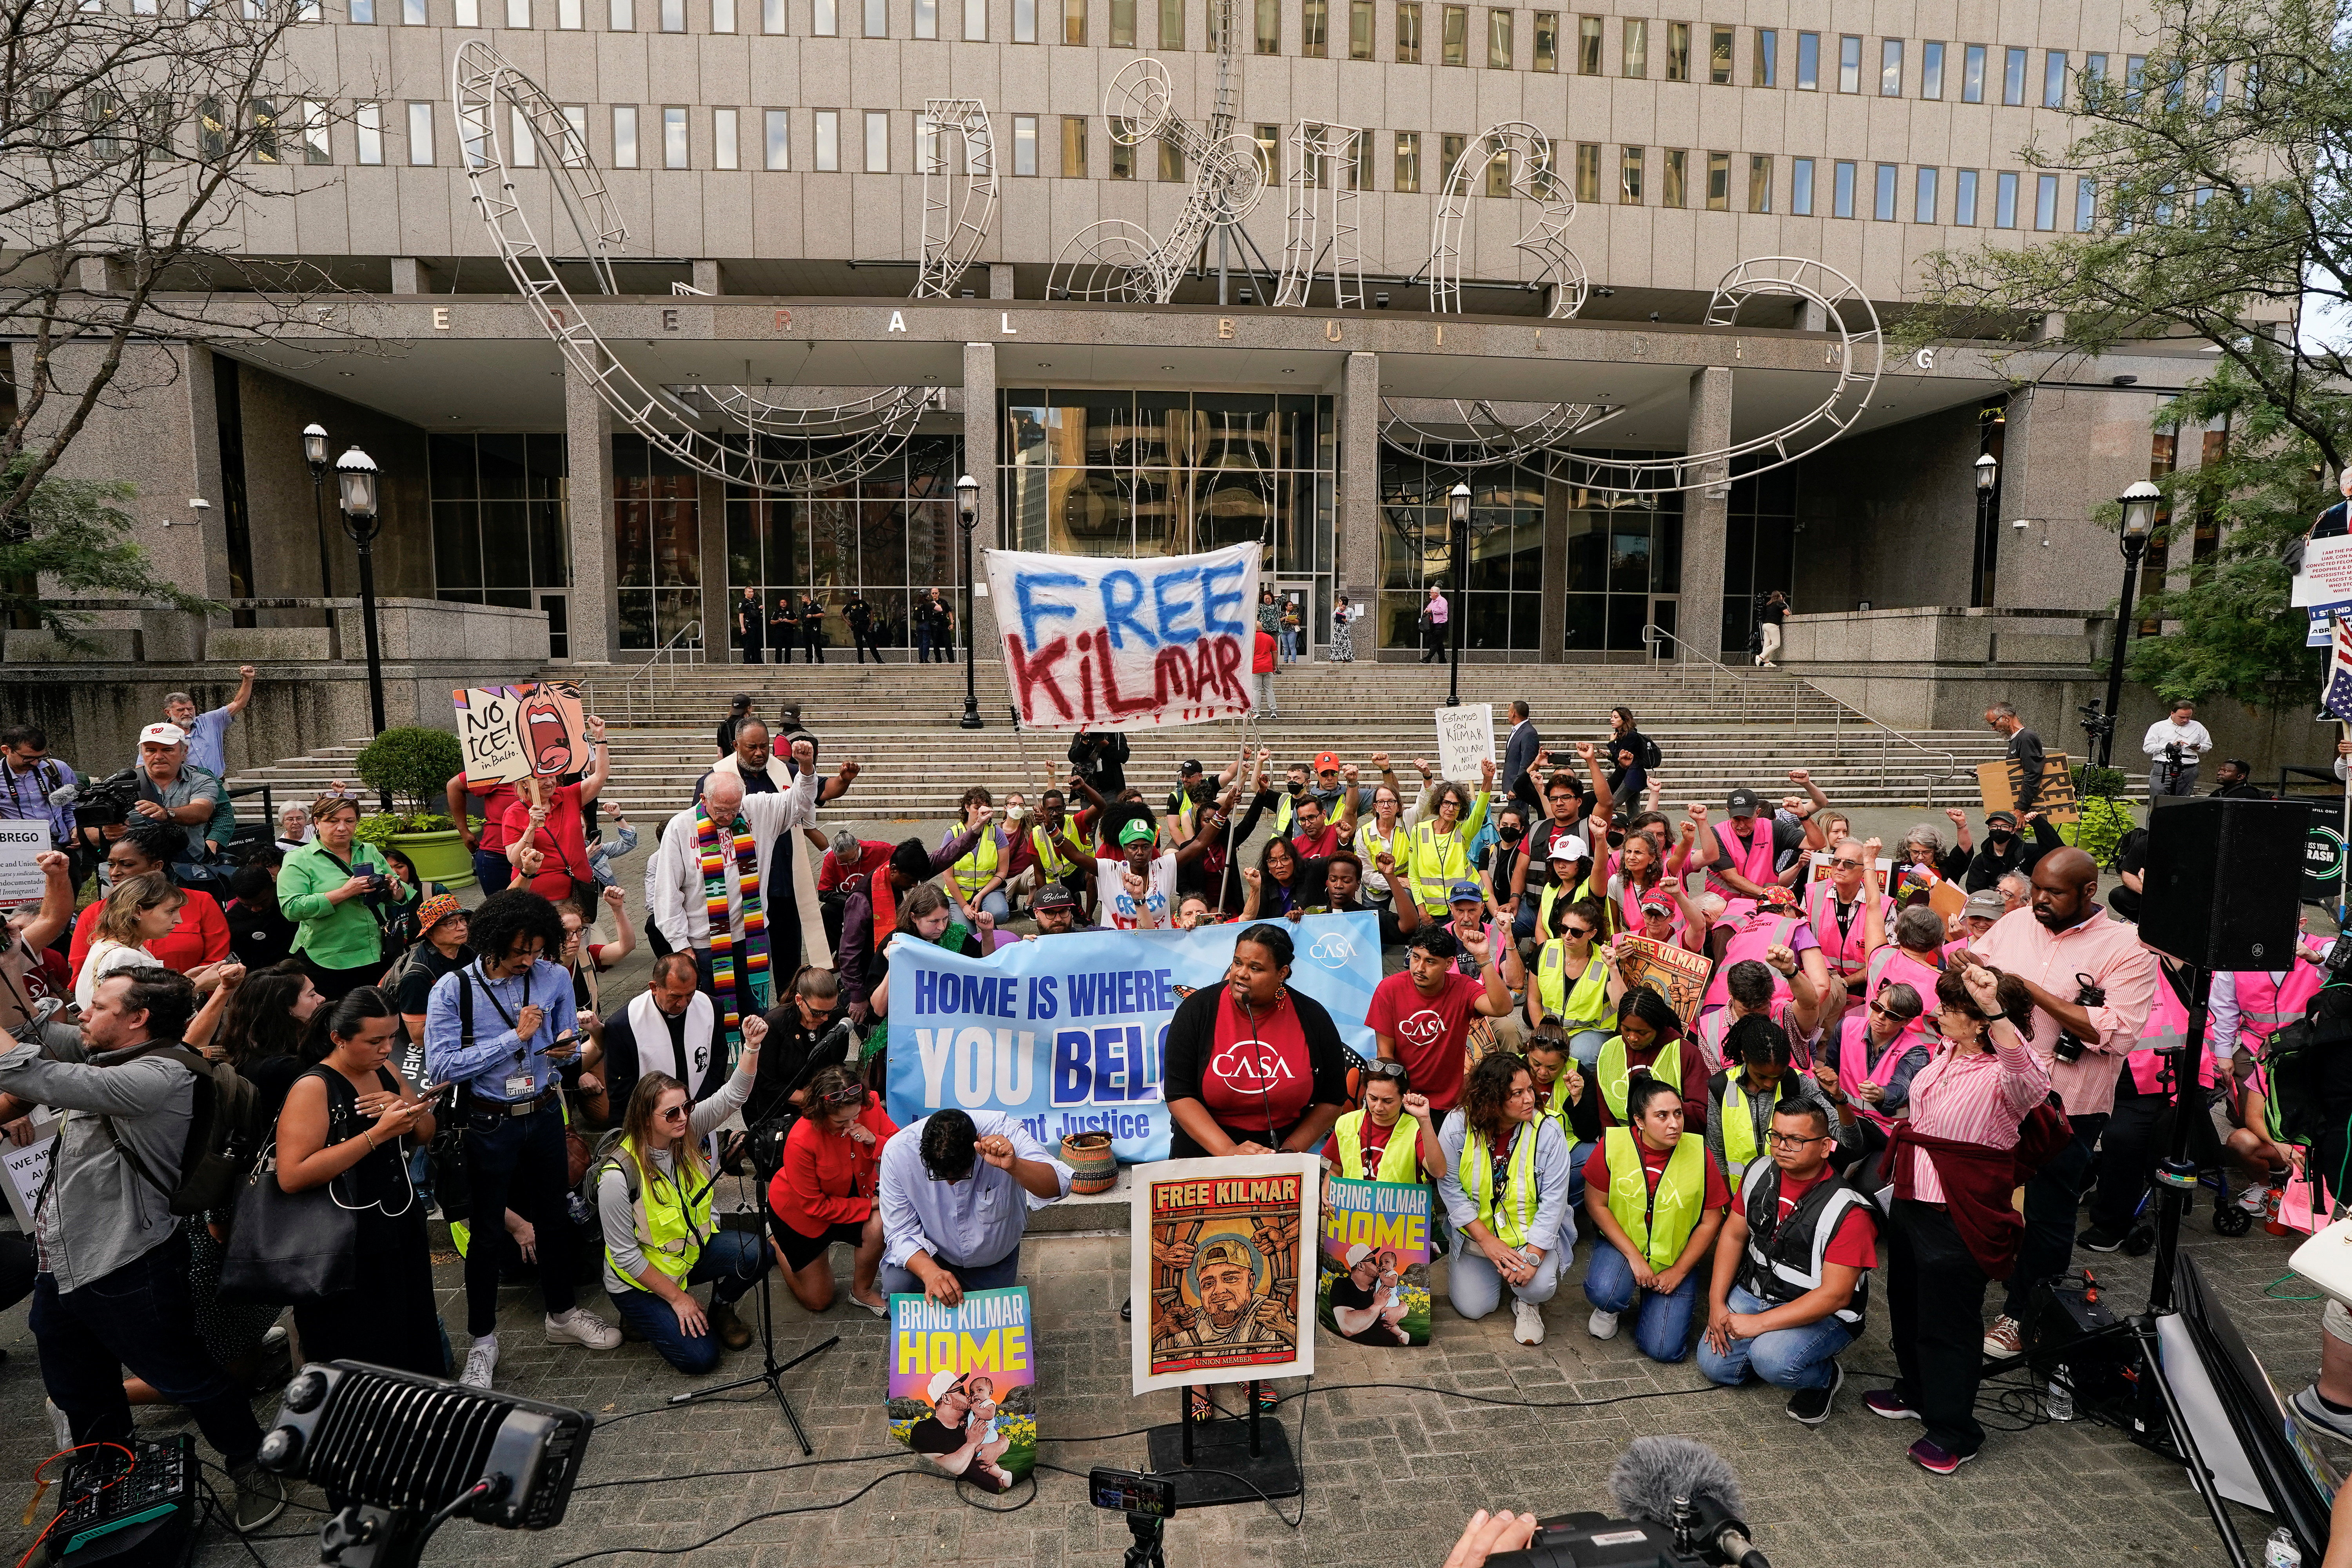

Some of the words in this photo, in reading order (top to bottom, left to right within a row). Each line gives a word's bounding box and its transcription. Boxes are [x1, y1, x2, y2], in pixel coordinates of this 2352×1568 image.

[317, 307, 1018, 334] FEDERAL
[1218, 318, 1934, 369] BUILDING
[1015, 560, 1244, 651] FREE
[466, 700, 504, 733] NO
[470, 720, 514, 762] ICE!
[1453, 745, 1468, 756] YOU
[482, 761, 493, 770] in
[491, 750, 519, 767] Balto.
[1461, 754, 1475, 764] NOT
[38, 777, 46, 791] SONY
[2042, 755, 2076, 815] FREE
[0, 833, 38, 842] BREGO
[2317, 843, 2329, 851] YOUR
[2307, 849, 2334, 862] RASH
[1818, 867, 1832, 878] FR
[3, 887, 38, 897] Immigrants!
[1116, 891, 1166, 915] CRSH
[1309, 941, 1358, 959] CASA
[1626, 936, 1656, 956] FREE
[1657, 944, 1708, 975] KILMAR
[915, 969, 1018, 1019] HOME
[1027, 975, 1058, 1020] IS
[1067, 968, 1174, 1017] WHERE
[1398, 1016, 1448, 1037] CASA
[915, 1026, 1035, 1109] YOU
[1050, 1021, 1172, 1109] BEL
[1212, 1052, 1296, 1079] CASA
[1056, 1109, 1149, 1142] Justice
[11, 1156, 33, 1170] WE
[35, 1149, 49, 1162] AR
[1156, 1183, 1210, 1209] FREE
[1216, 1179, 1296, 1205] KILMAR
[1328, 1182, 1371, 1212] BRING
[1375, 1187, 1426, 1214] KILMAR
[1327, 1207, 1425, 1250] HOME
[898, 1299, 951, 1330] BRING
[958, 1294, 1024, 1330] KILMAR
[898, 1326, 1027, 1374] HOME
[1221, 1355, 1253, 1364] MEMBER
